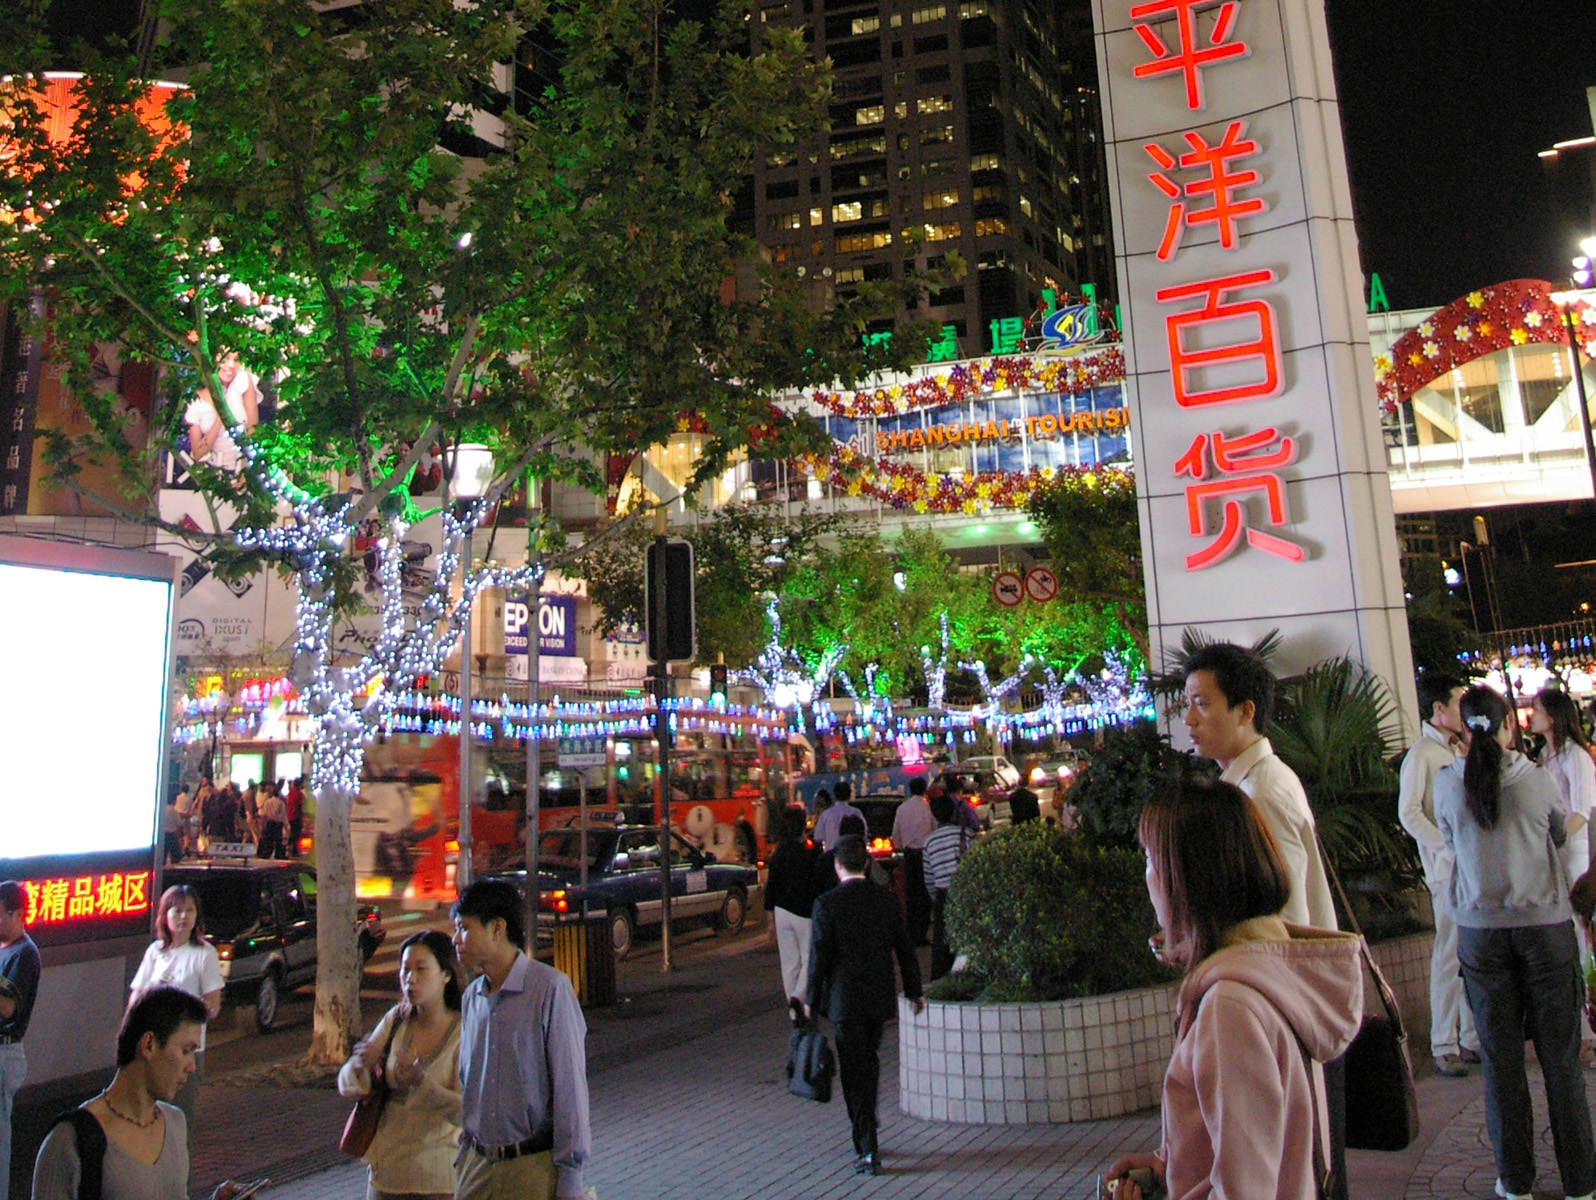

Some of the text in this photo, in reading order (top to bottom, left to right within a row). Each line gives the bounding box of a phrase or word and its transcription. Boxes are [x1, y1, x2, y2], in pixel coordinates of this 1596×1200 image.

[875, 421, 1008, 450] SHANGHAI
[505, 602, 565, 635] EPON
[214, 844, 246, 854] TAXI
